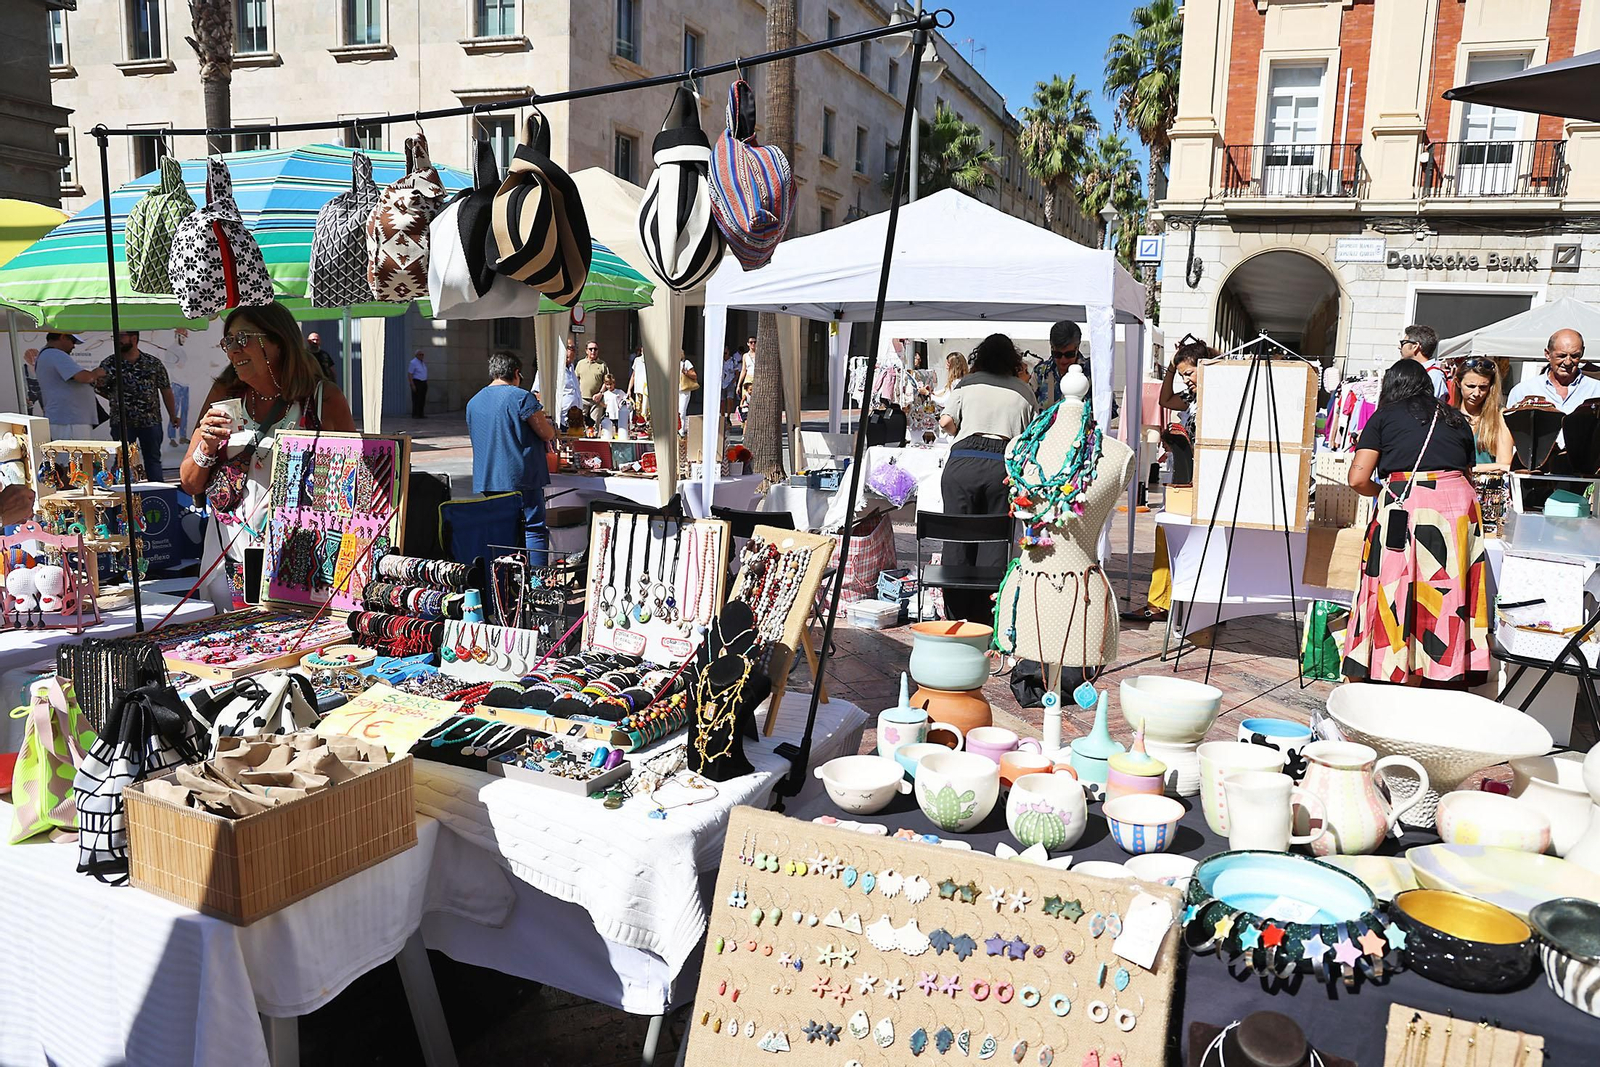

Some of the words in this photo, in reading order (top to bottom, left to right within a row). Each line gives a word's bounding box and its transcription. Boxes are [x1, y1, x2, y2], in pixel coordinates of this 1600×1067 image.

[1387, 250, 1480, 270] Deutsche
[1486, 251, 1539, 271] Bank
[383, 694, 441, 711] SOBRES
